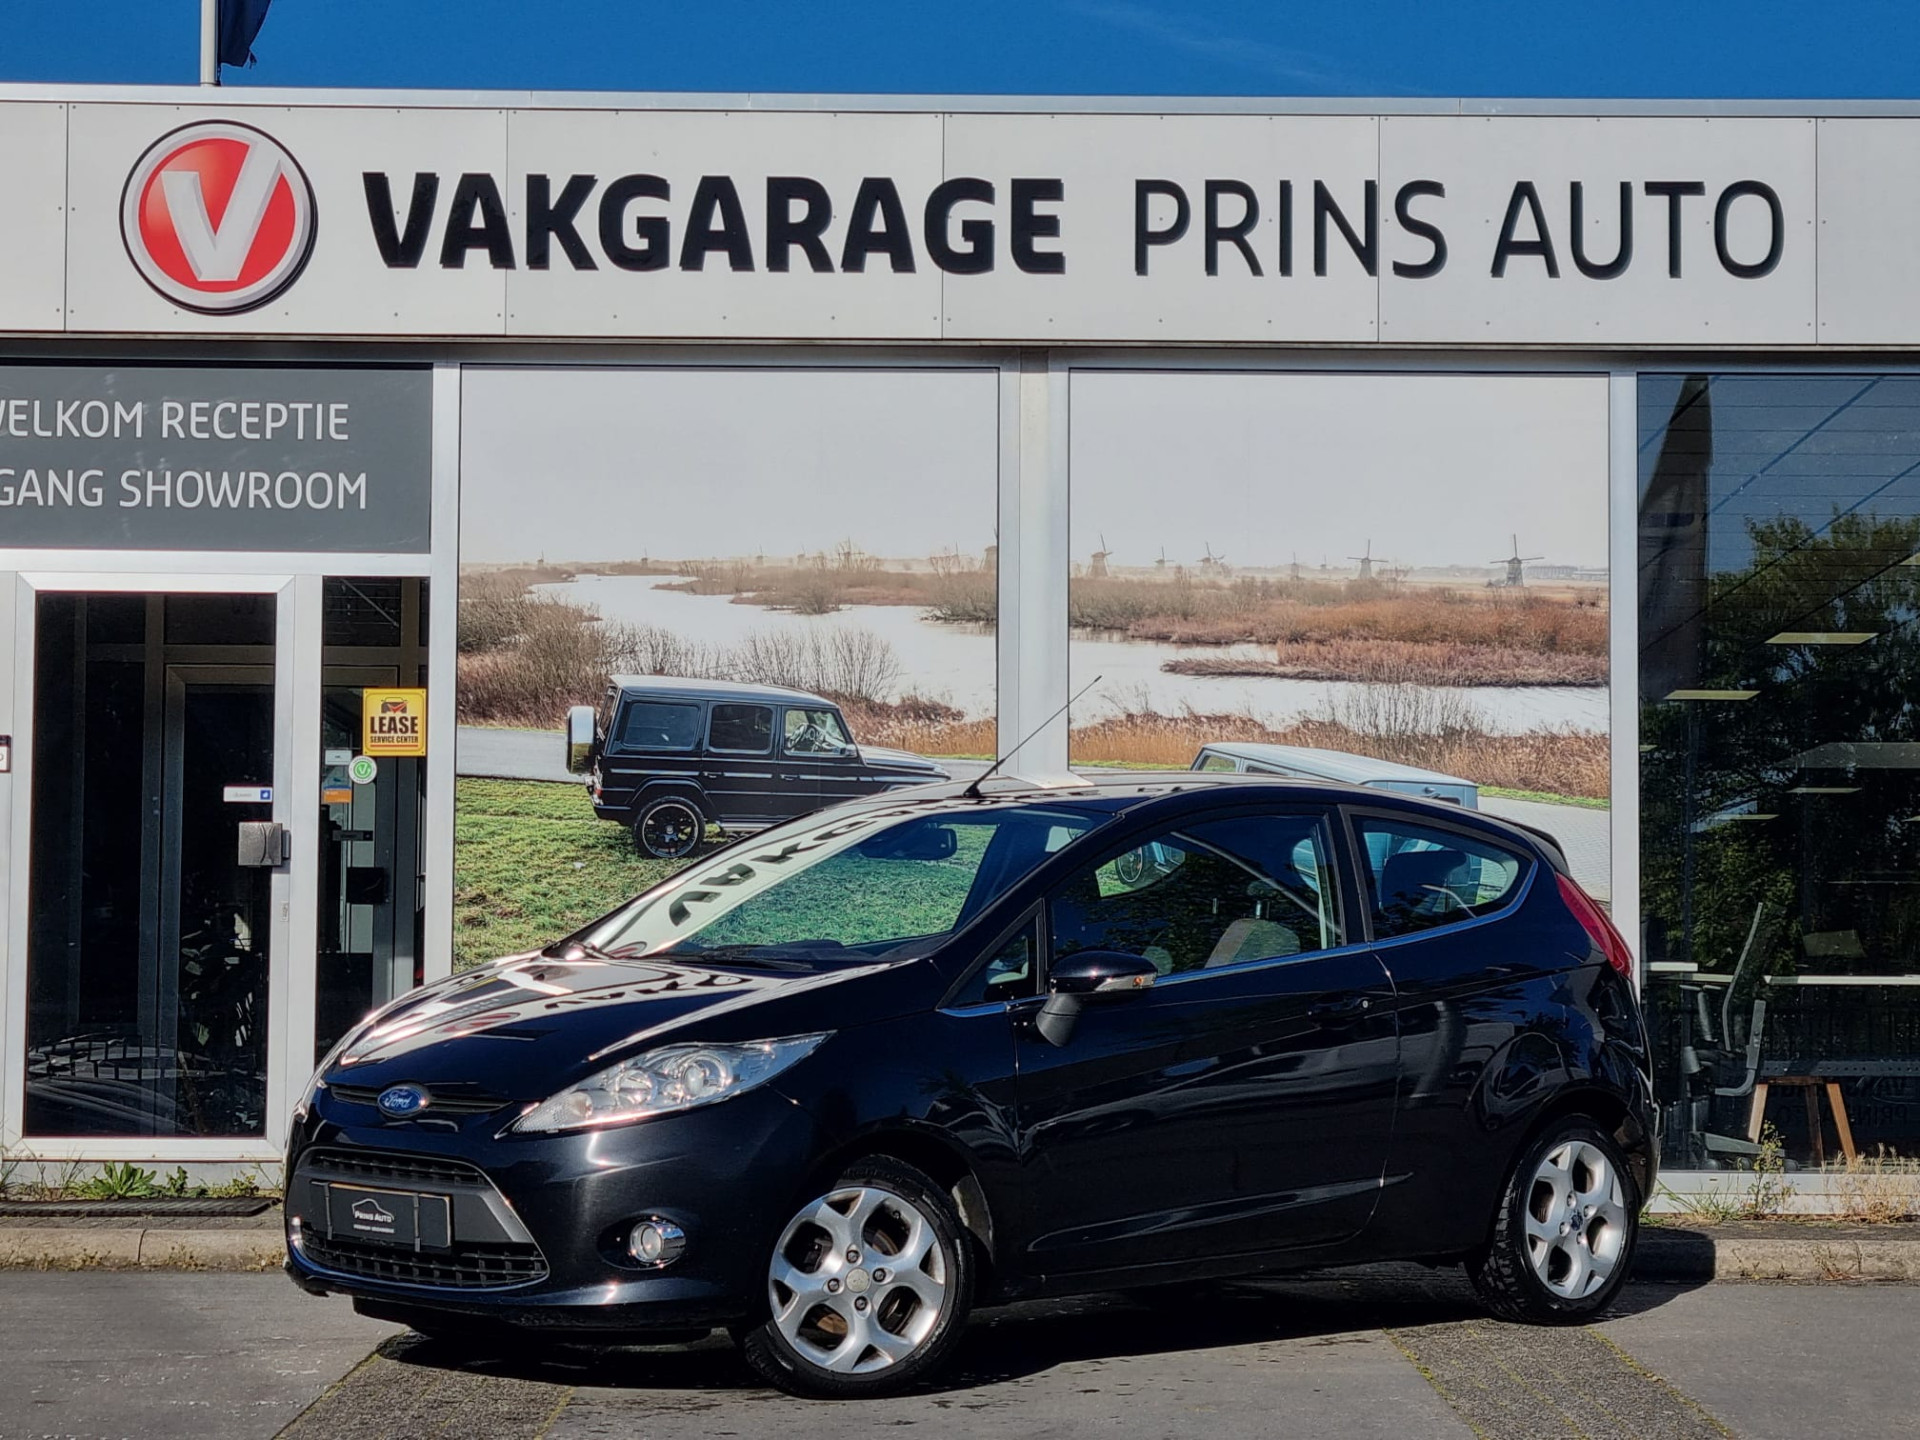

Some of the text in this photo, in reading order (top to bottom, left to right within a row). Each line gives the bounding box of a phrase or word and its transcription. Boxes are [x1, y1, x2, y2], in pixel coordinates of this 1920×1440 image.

[362, 171, 1785, 281] VAKGARAGE PRINS AUTO
[0, 399, 349, 440] ELKOM RECEPTIE
[119, 469, 367, 510] SHOWROOM
[370, 716, 418, 734] LEASE
[370, 735, 418, 744] SERVICE CENTER
[383, 1090, 413, 1108] Ford
